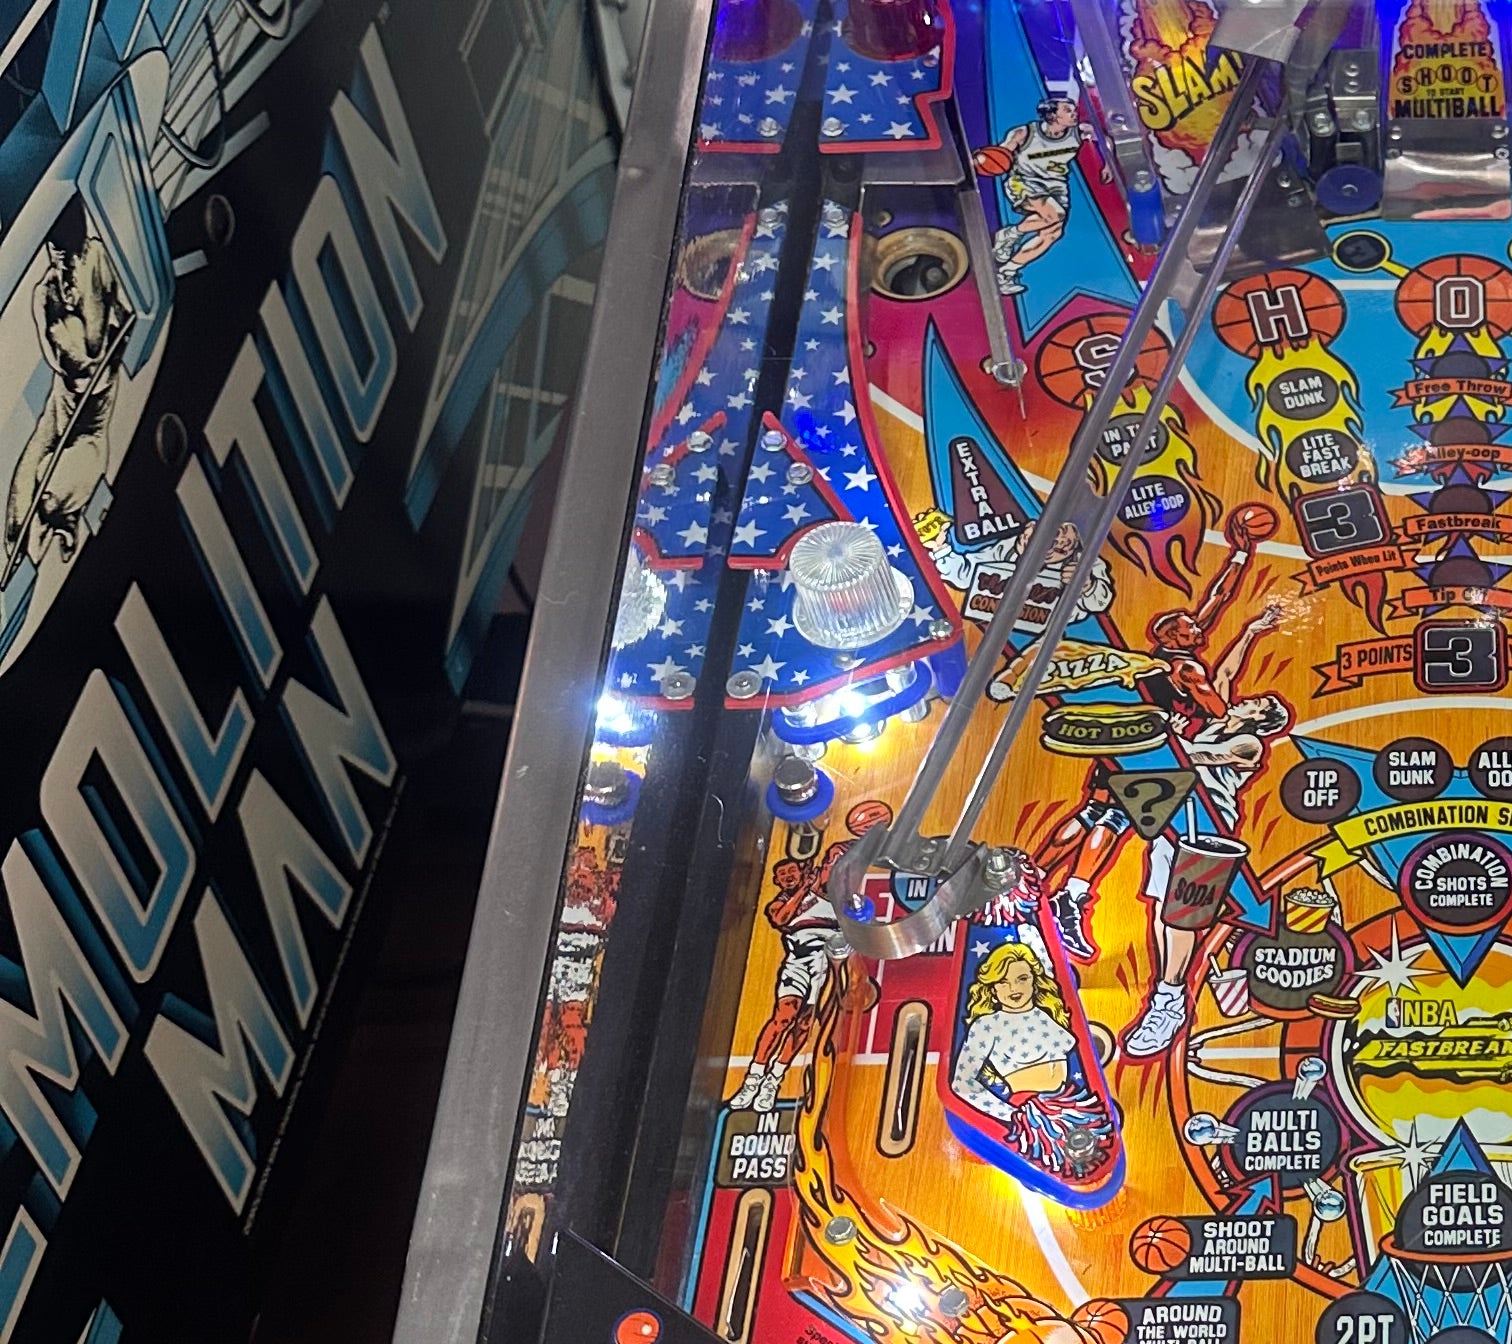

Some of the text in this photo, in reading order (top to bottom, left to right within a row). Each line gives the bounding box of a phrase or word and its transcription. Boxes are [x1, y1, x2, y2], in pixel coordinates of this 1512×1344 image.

[1402, 42, 1487, 59] COMPLETE
[1395, 96, 1499, 118] MULTIBALL
[1247, 285, 1310, 343] H
[1279, 376, 1323, 395] SLAM
[1414, 380, 1508, 397] Free Throw
[1284, 390, 1325, 408] DUNK
[1302, 434, 1335, 450] LITE
[1302, 446, 1341, 464] FAST
[1300, 457, 1352, 479] BREAK
[957, 442, 992, 530] EXTRA
[1131, 483, 1166, 501] LITE
[964, 514, 1021, 540] BALL
[1300, 494, 1380, 553] 3
[1416, 514, 1502, 533] Fastbreak
[1356, 644, 1413, 668] POINTS
[1424, 625, 1500, 687] 3
[1043, 653, 1130, 682] PIZZA
[1059, 720, 1154, 739] HOT DOG
[1389, 752, 1436, 767] SLAM
[1307, 770, 1338, 789] TIP
[1389, 769, 1435, 785] DUNK
[1303, 788, 1339, 807] OFF
[1364, 804, 1488, 837] COMBINATION
[1414, 843, 1509, 891] COMBINATION
[908, 878, 927, 898] IN
[1174, 880, 1215, 908] SODA
[1436, 877, 1487, 892] SHOTS
[144, 594, 398, 1217] MAN
[1430, 893, 1493, 907] COMPLETE
[1255, 947, 1336, 964] STADIUM
[1255, 964, 1334, 989] GOODIES
[1404, 1001, 1458, 1027] NBA
[756, 1113, 778, 1134] IN
[1251, 1110, 1318, 1132] MULTI
[730, 1134, 796, 1157] BOUND
[1247, 1130, 1321, 1152] BALLS
[733, 1157, 787, 1180] PASS
[1244, 1154, 1321, 1171] COMPLETE
[1430, 1184, 1497, 1204] FIELD
[1423, 1205, 1504, 1226] GOALS
[1203, 1220, 1275, 1238] SHOOT
[1424, 1230, 1501, 1247] COMPLETE
[1203, 1239, 1269, 1255] AROUND
[1189, 1256, 1285, 1273] MULTI-BALL
[1142, 1305, 1222, 1325] AROUND
[1136, 1324, 1227, 1338] THE WORLD
